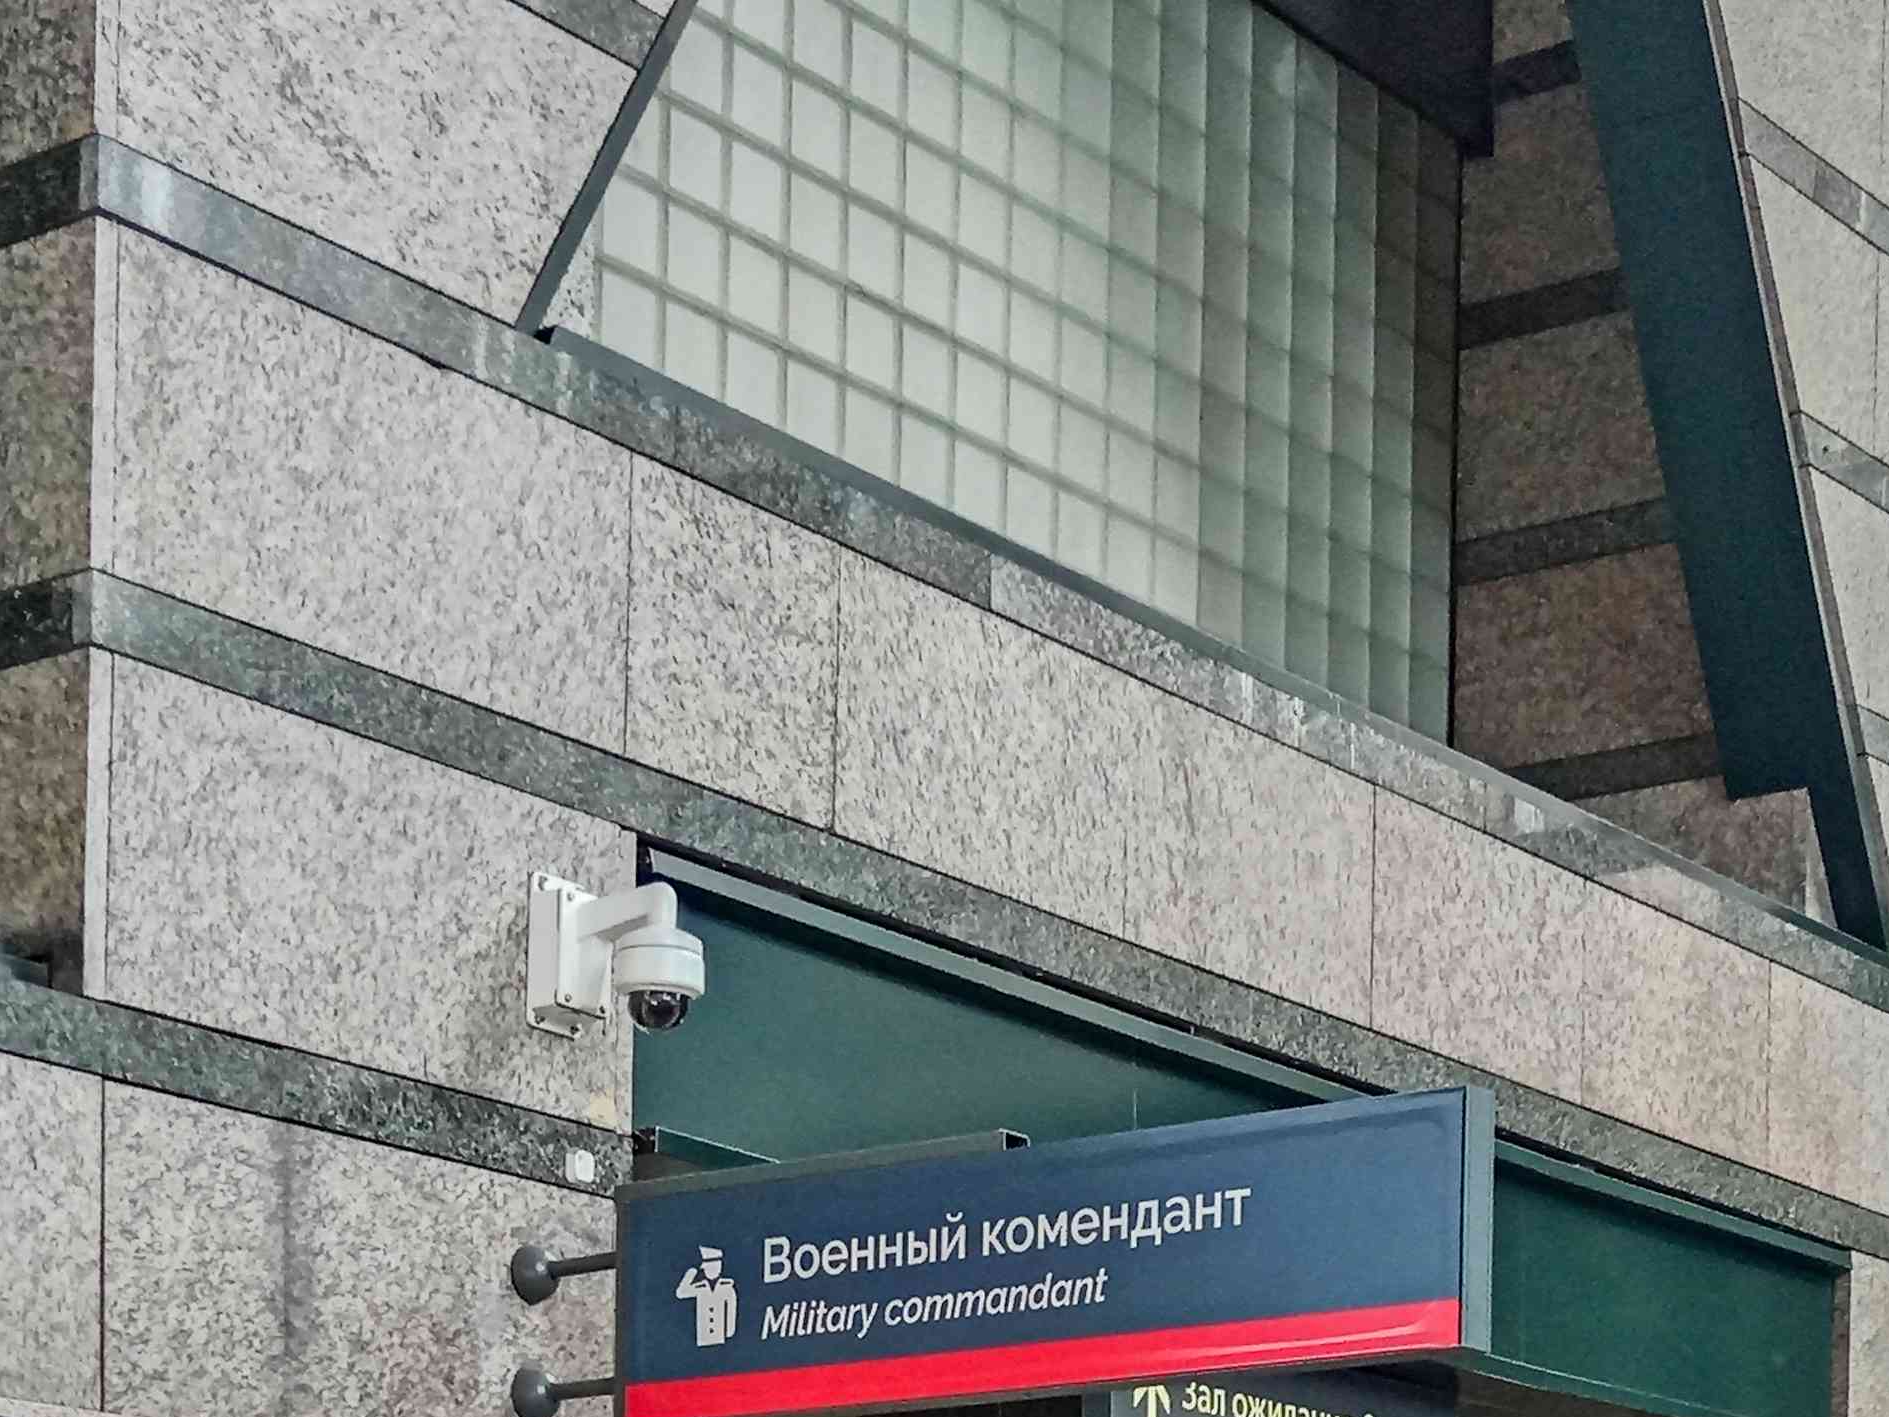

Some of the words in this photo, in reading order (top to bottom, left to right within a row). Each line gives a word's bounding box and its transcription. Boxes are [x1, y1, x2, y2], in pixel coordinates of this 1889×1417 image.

[763, 1211, 967, 1284] Военный
[981, 1187, 1252, 1257] комендант
[760, 1299, 878, 1340] Military
[884, 1267, 1109, 1327] commandant
[1181, 1381, 1227, 1417] Зал
